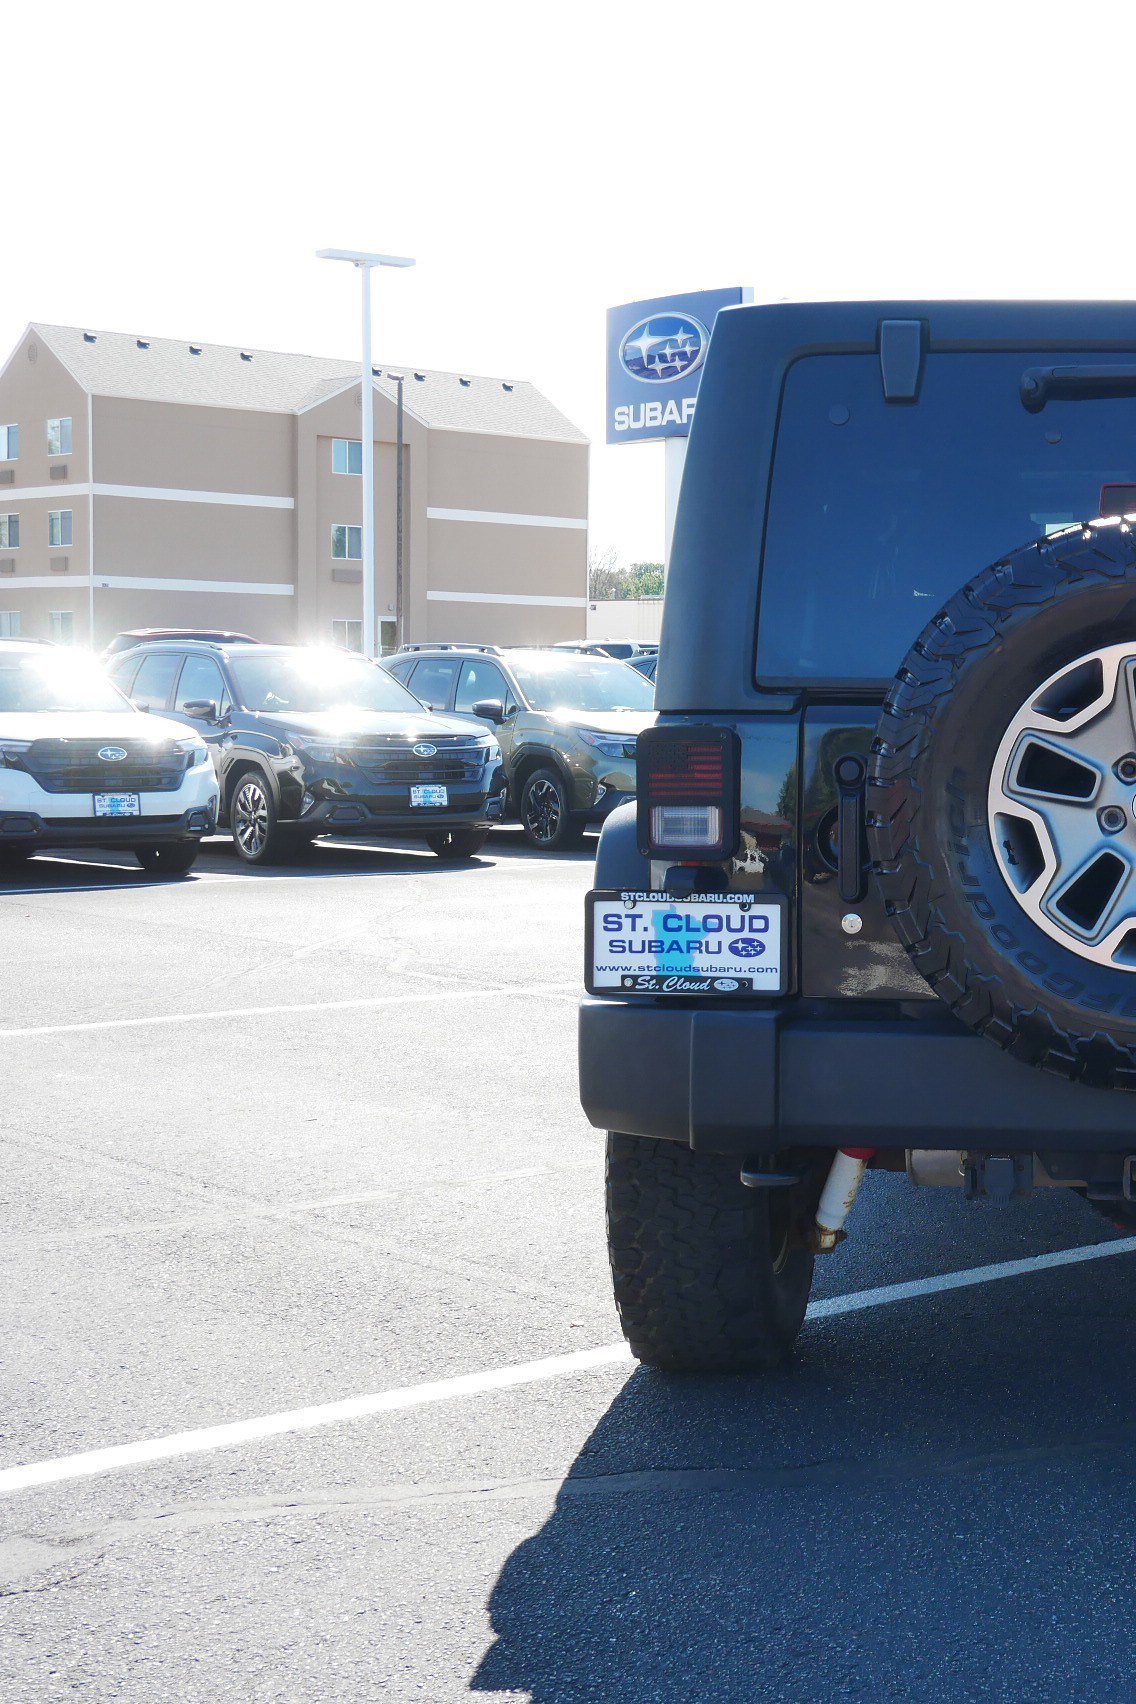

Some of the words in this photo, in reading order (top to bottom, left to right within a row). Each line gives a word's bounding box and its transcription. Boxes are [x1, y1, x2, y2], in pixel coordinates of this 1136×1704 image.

[620, 892, 755, 903] STCLOUBARU.COM
[602, 913, 649, 932] ST.
[662, 914, 770, 933] CLOUD
[608, 939, 722, 954] SUBARU
[595, 963, 778, 974] www.stcloudsubaru.com
[635, 976, 660, 990] St.
[662, 976, 711, 991] Cloud
